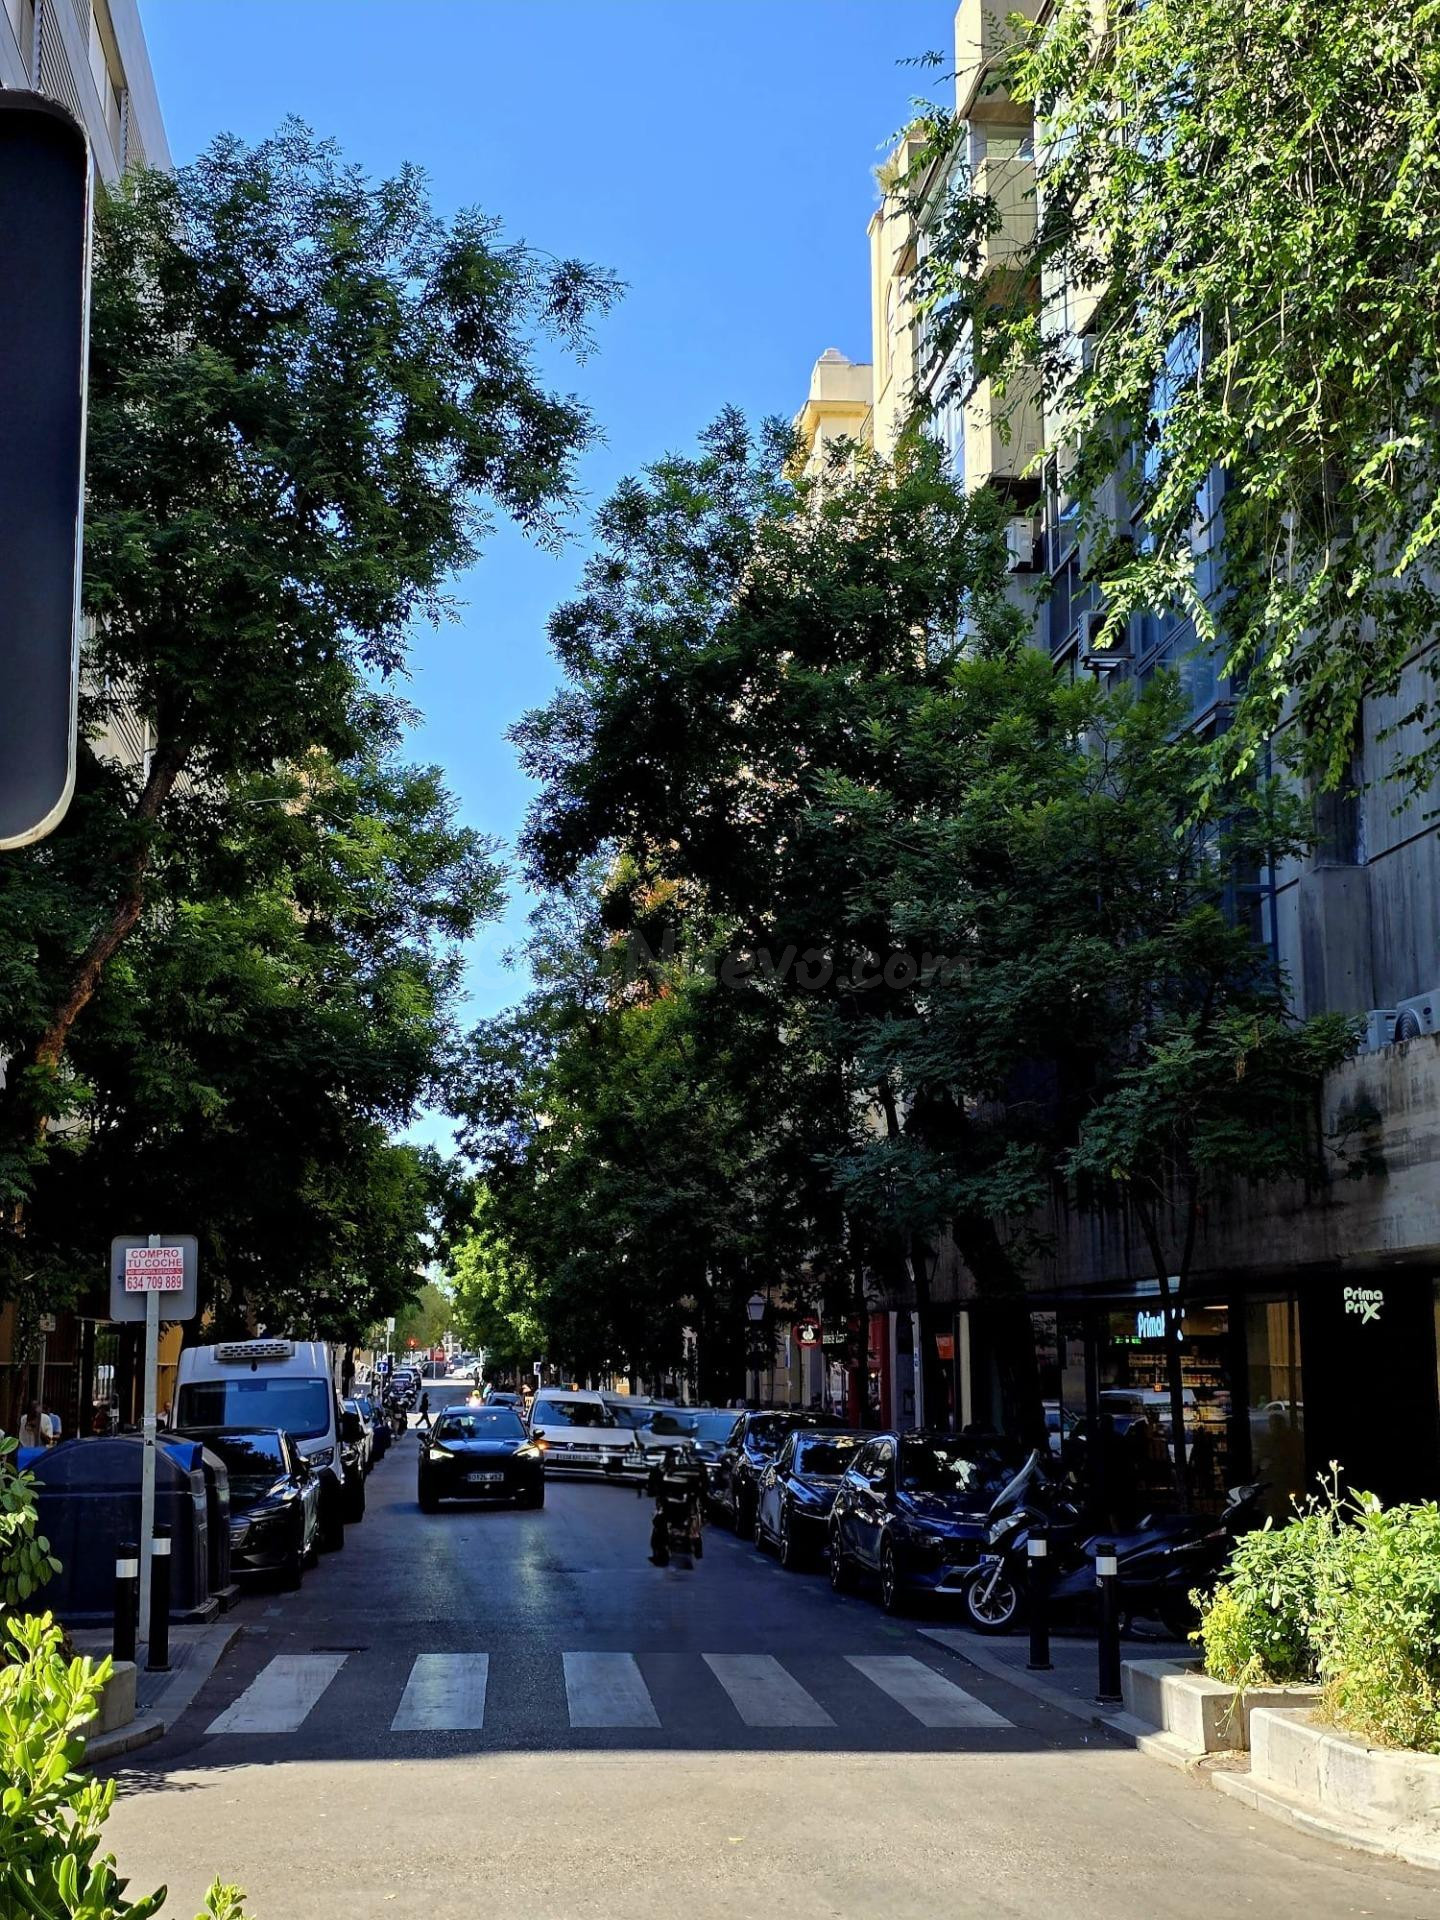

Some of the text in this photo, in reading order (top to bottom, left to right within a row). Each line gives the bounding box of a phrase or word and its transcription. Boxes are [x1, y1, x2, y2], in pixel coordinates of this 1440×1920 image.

[131, 1249, 179, 1258] COMPRO
[127, 1258, 182, 1268] TU COCHE
[127, 1275, 182, 1289] 634 709 889
[1343, 1286, 1383, 1301] Prima
